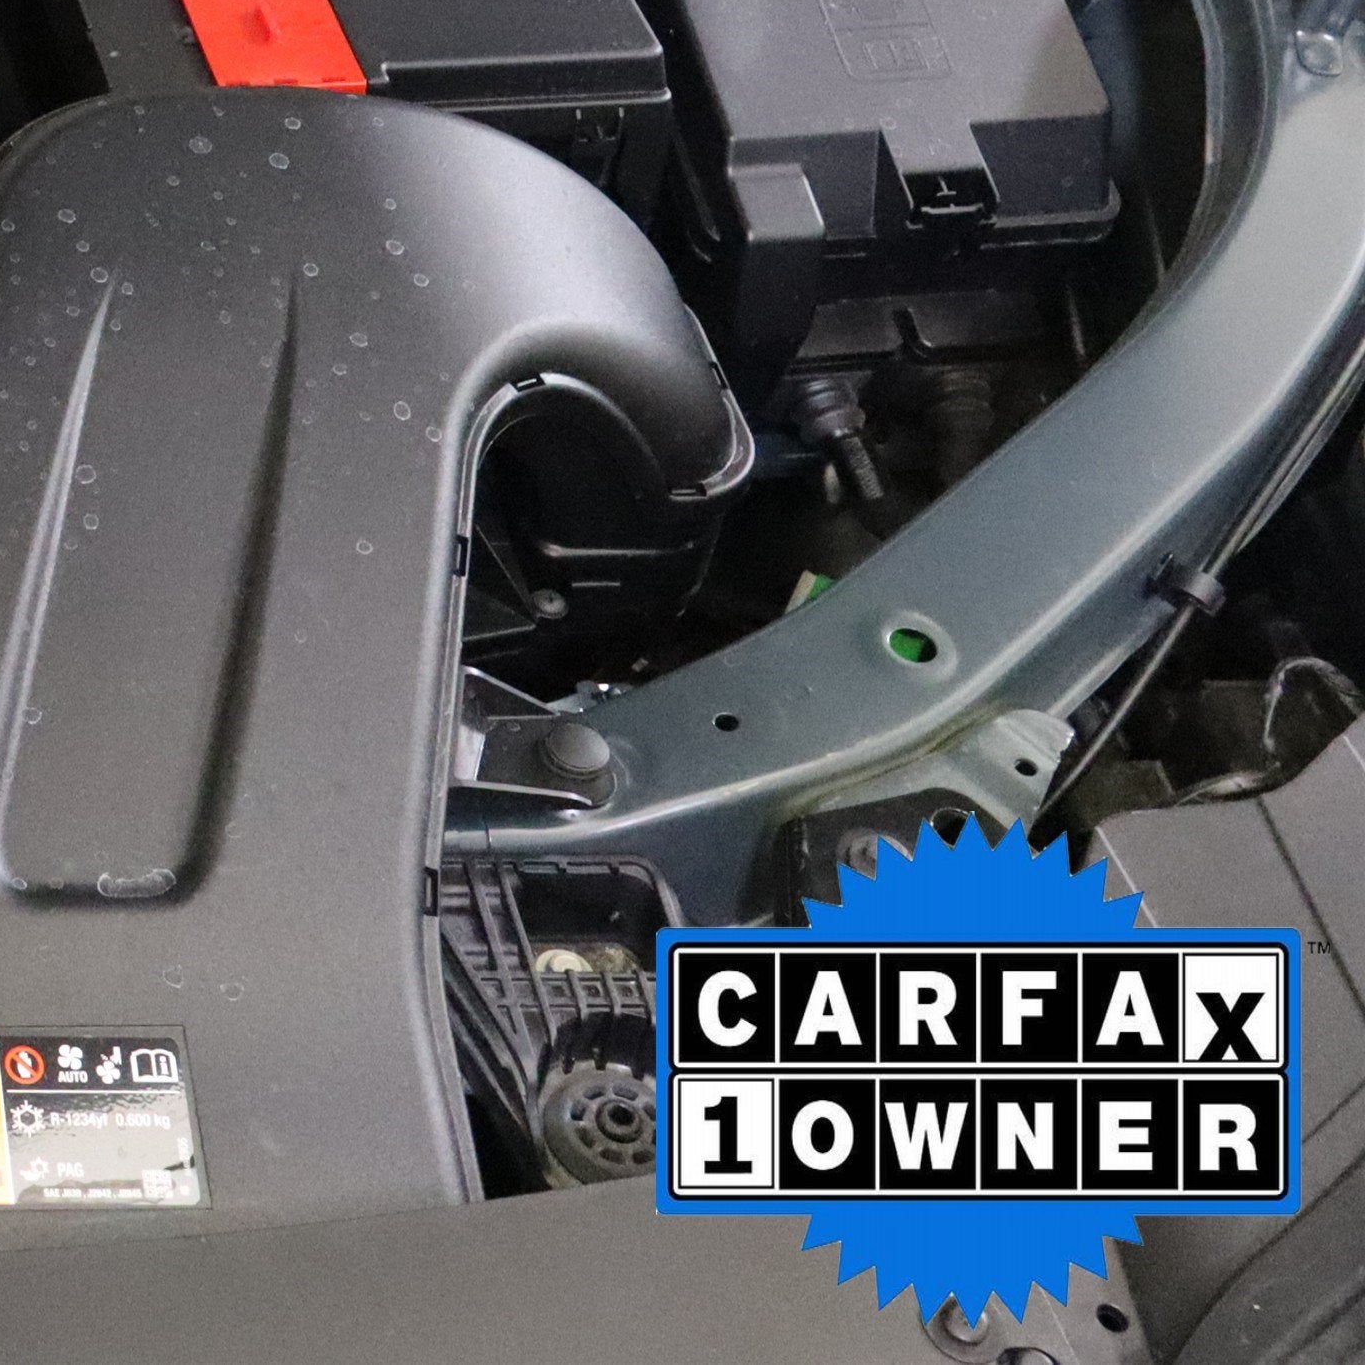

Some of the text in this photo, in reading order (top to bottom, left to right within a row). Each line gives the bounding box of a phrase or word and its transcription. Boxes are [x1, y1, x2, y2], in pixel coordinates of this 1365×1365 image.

[57, 1070, 89, 1084] AUTO
[49, 1112, 171, 1130] R-1234yf 0.600 kg
[56, 1162, 85, 1178] PAG
